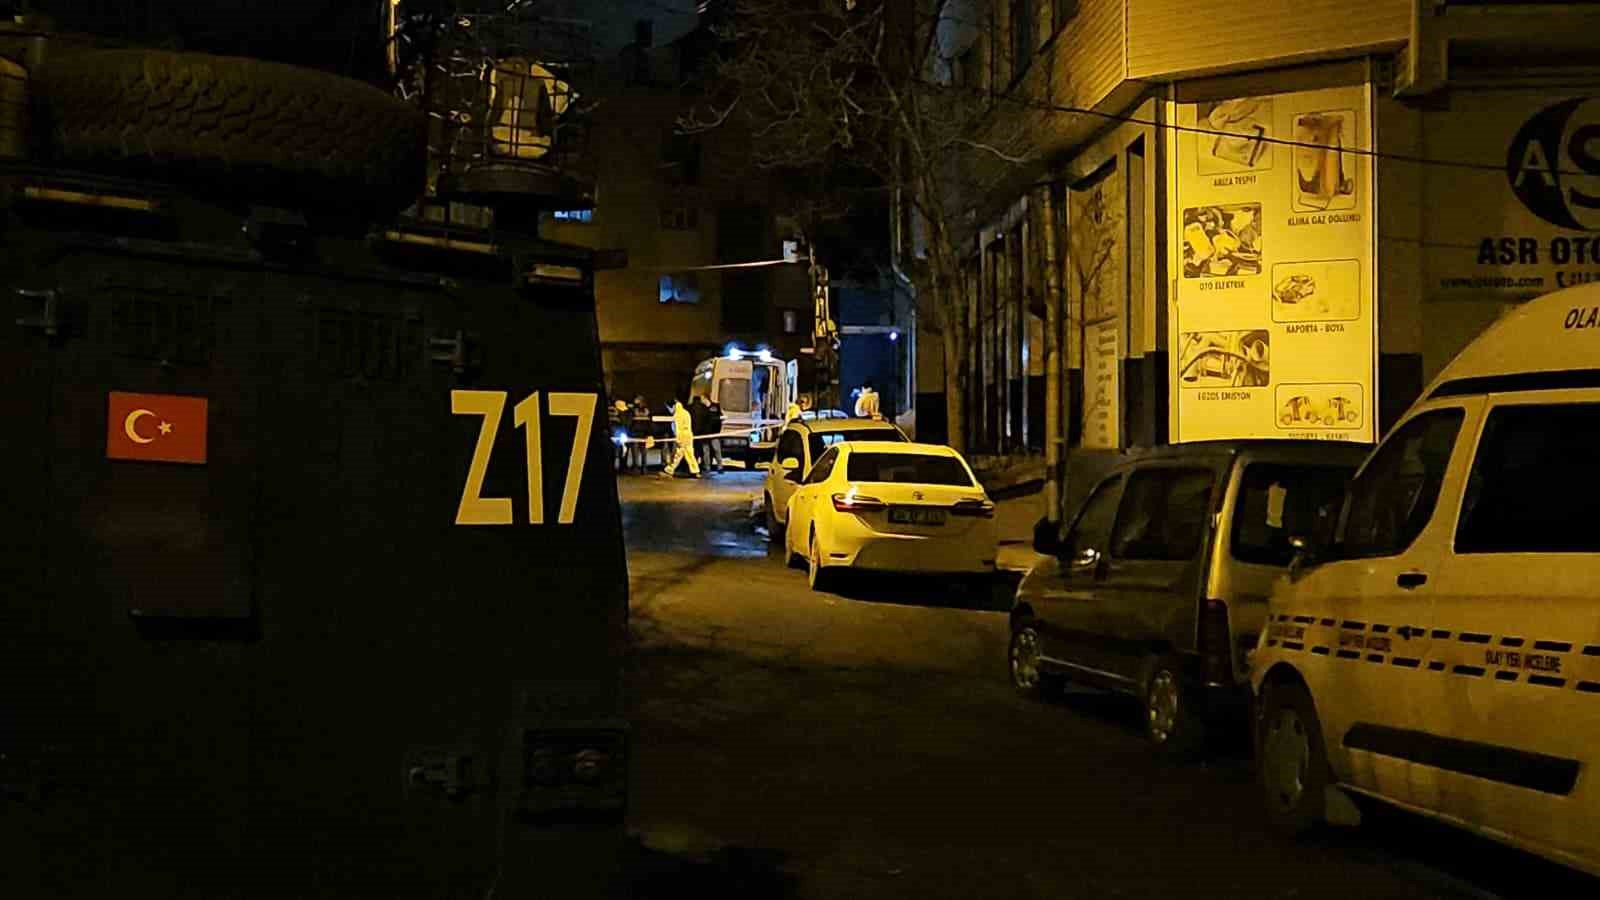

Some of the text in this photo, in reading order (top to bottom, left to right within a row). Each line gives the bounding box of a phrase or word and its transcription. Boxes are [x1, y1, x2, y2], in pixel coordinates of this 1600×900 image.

[1477, 236, 1539, 265] ASR
[1564, 306, 1600, 329] OLA
[451, 389, 598, 525] Z17
